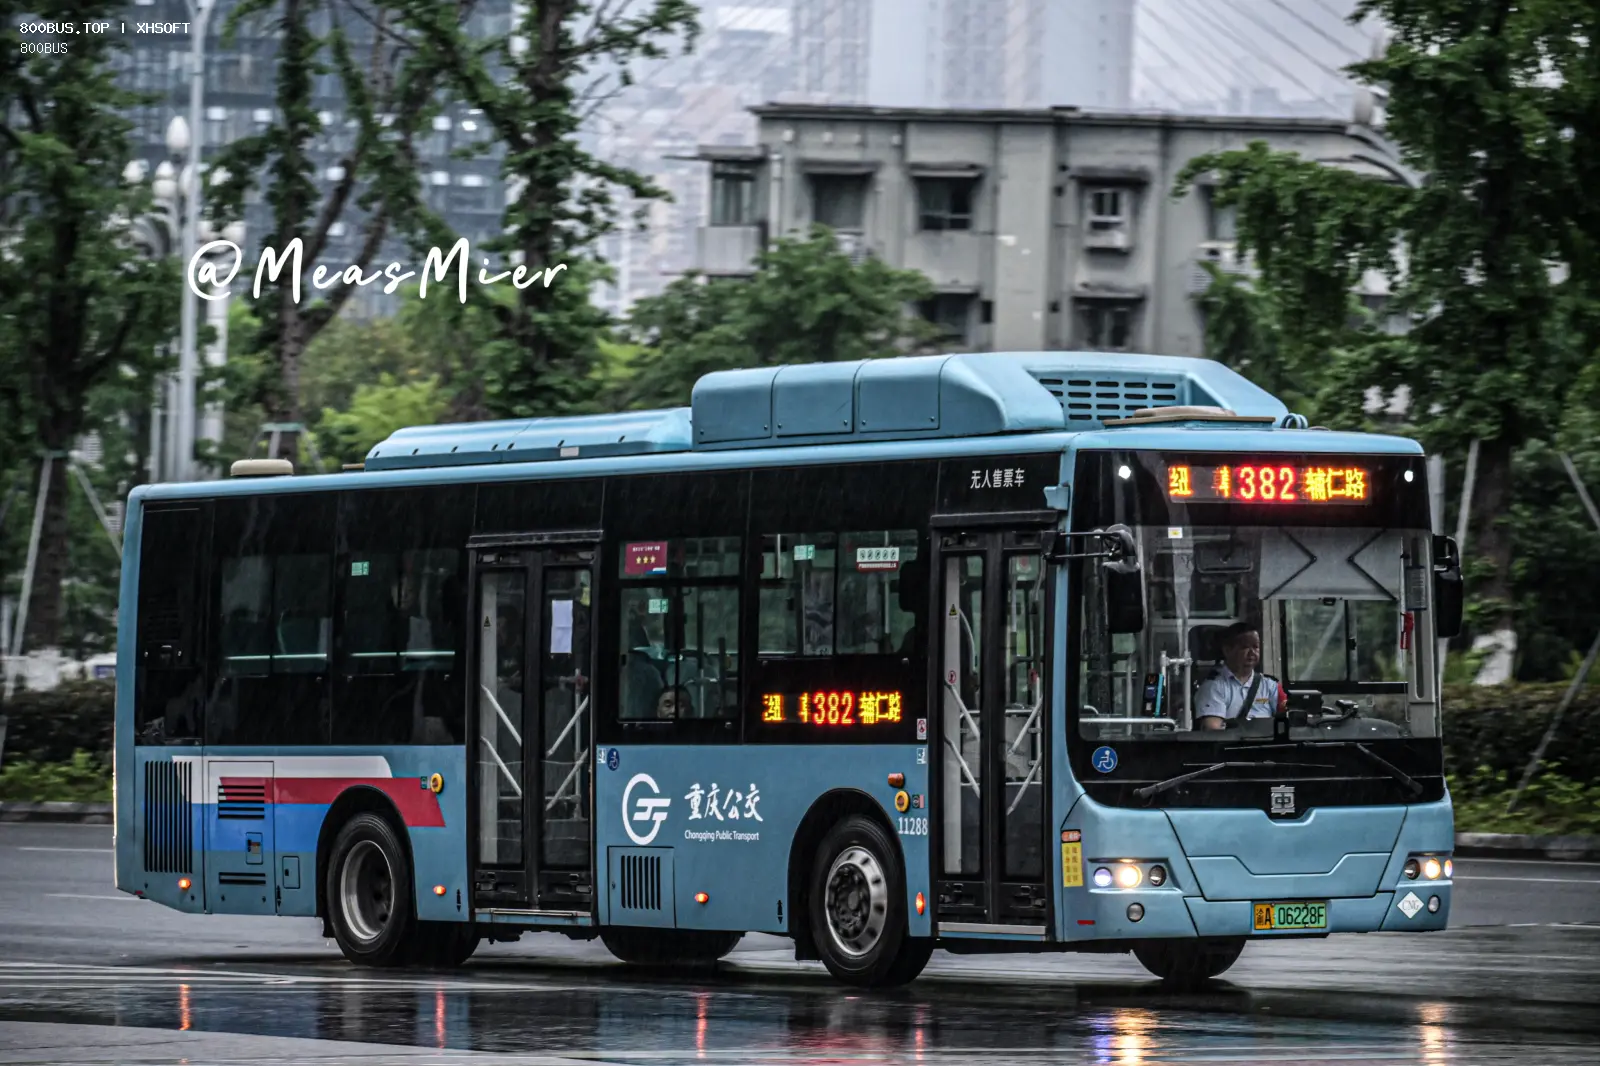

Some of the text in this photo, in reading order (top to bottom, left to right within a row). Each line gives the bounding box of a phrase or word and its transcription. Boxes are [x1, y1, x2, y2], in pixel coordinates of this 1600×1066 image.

[970, 467, 1025, 489] 无人售票车
[1238, 466, 1296, 501] 382
[1304, 466, 1367, 500] 辅仁路
[813, 691, 854, 725] 382
[684, 782, 764, 822] 重庆公交
[684, 829, 760, 843] Chongqing Public Transport
[898, 817, 929, 836] 11288
[1402, 900, 1420, 911] CNG
